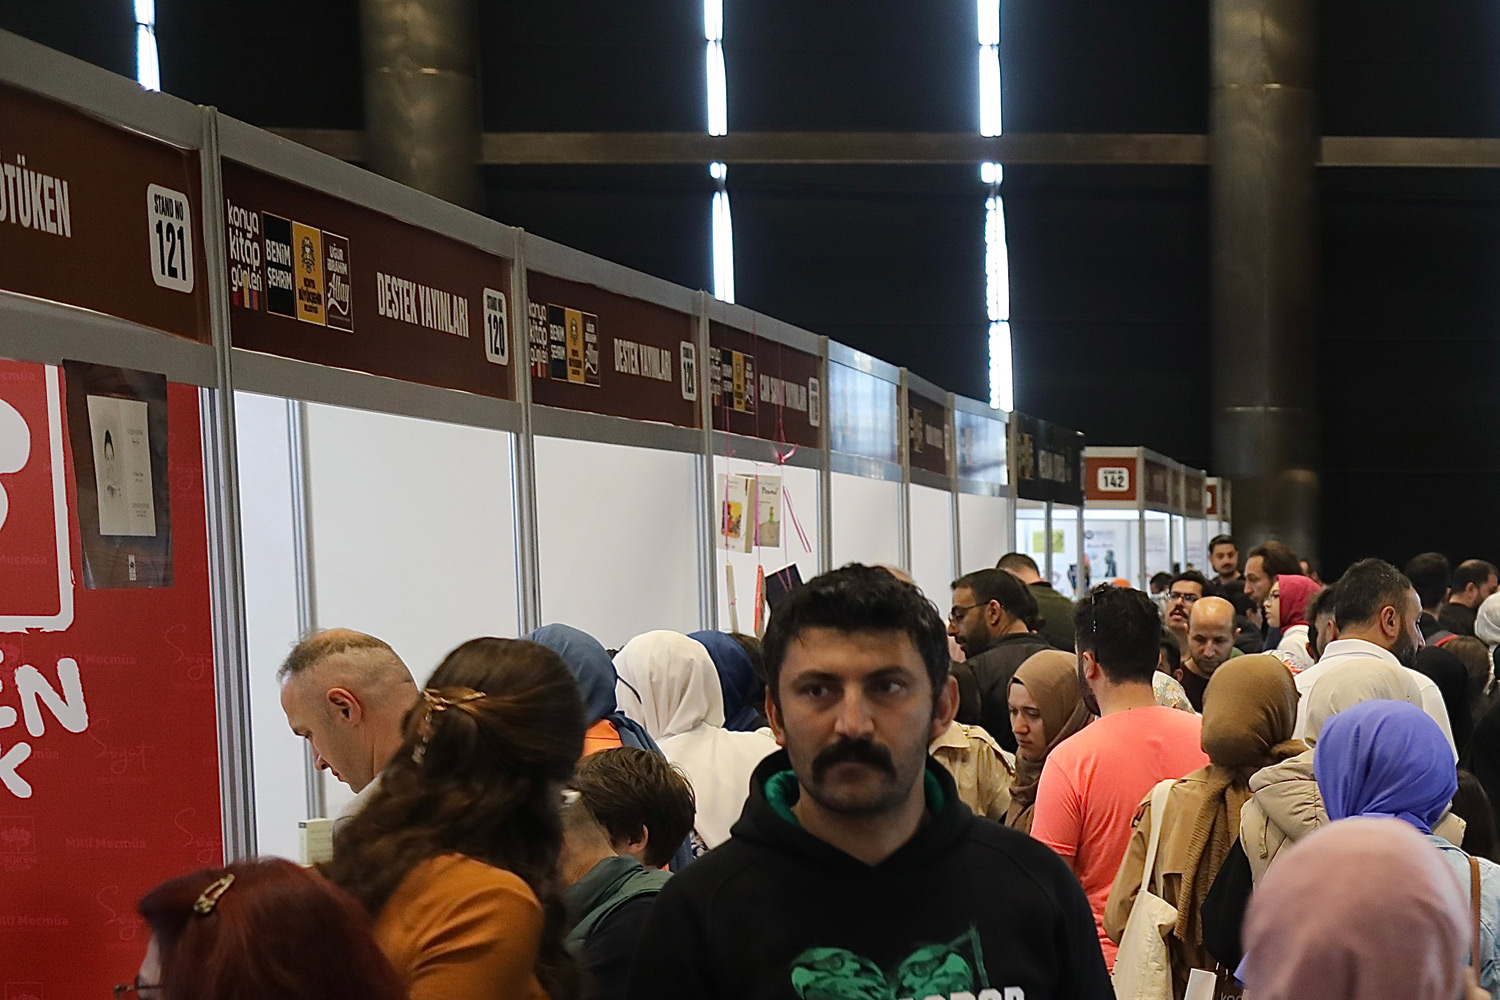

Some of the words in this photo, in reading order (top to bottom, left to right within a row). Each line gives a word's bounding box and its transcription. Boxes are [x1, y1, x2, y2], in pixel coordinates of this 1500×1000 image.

[154, 193, 174, 219] STAND
[175, 200, 184, 222] NO
[227, 198, 259, 239] konya
[156, 219, 187, 282] 121
[229, 227, 260, 272] kitap
[265, 238, 291, 267] BENİM
[231, 263, 262, 292] günleri
[377, 271, 419, 325] DESTEK
[418, 284, 470, 338] YAYINLARI
[488, 314, 505, 357] 120
[1103, 475, 1125, 488] 142
